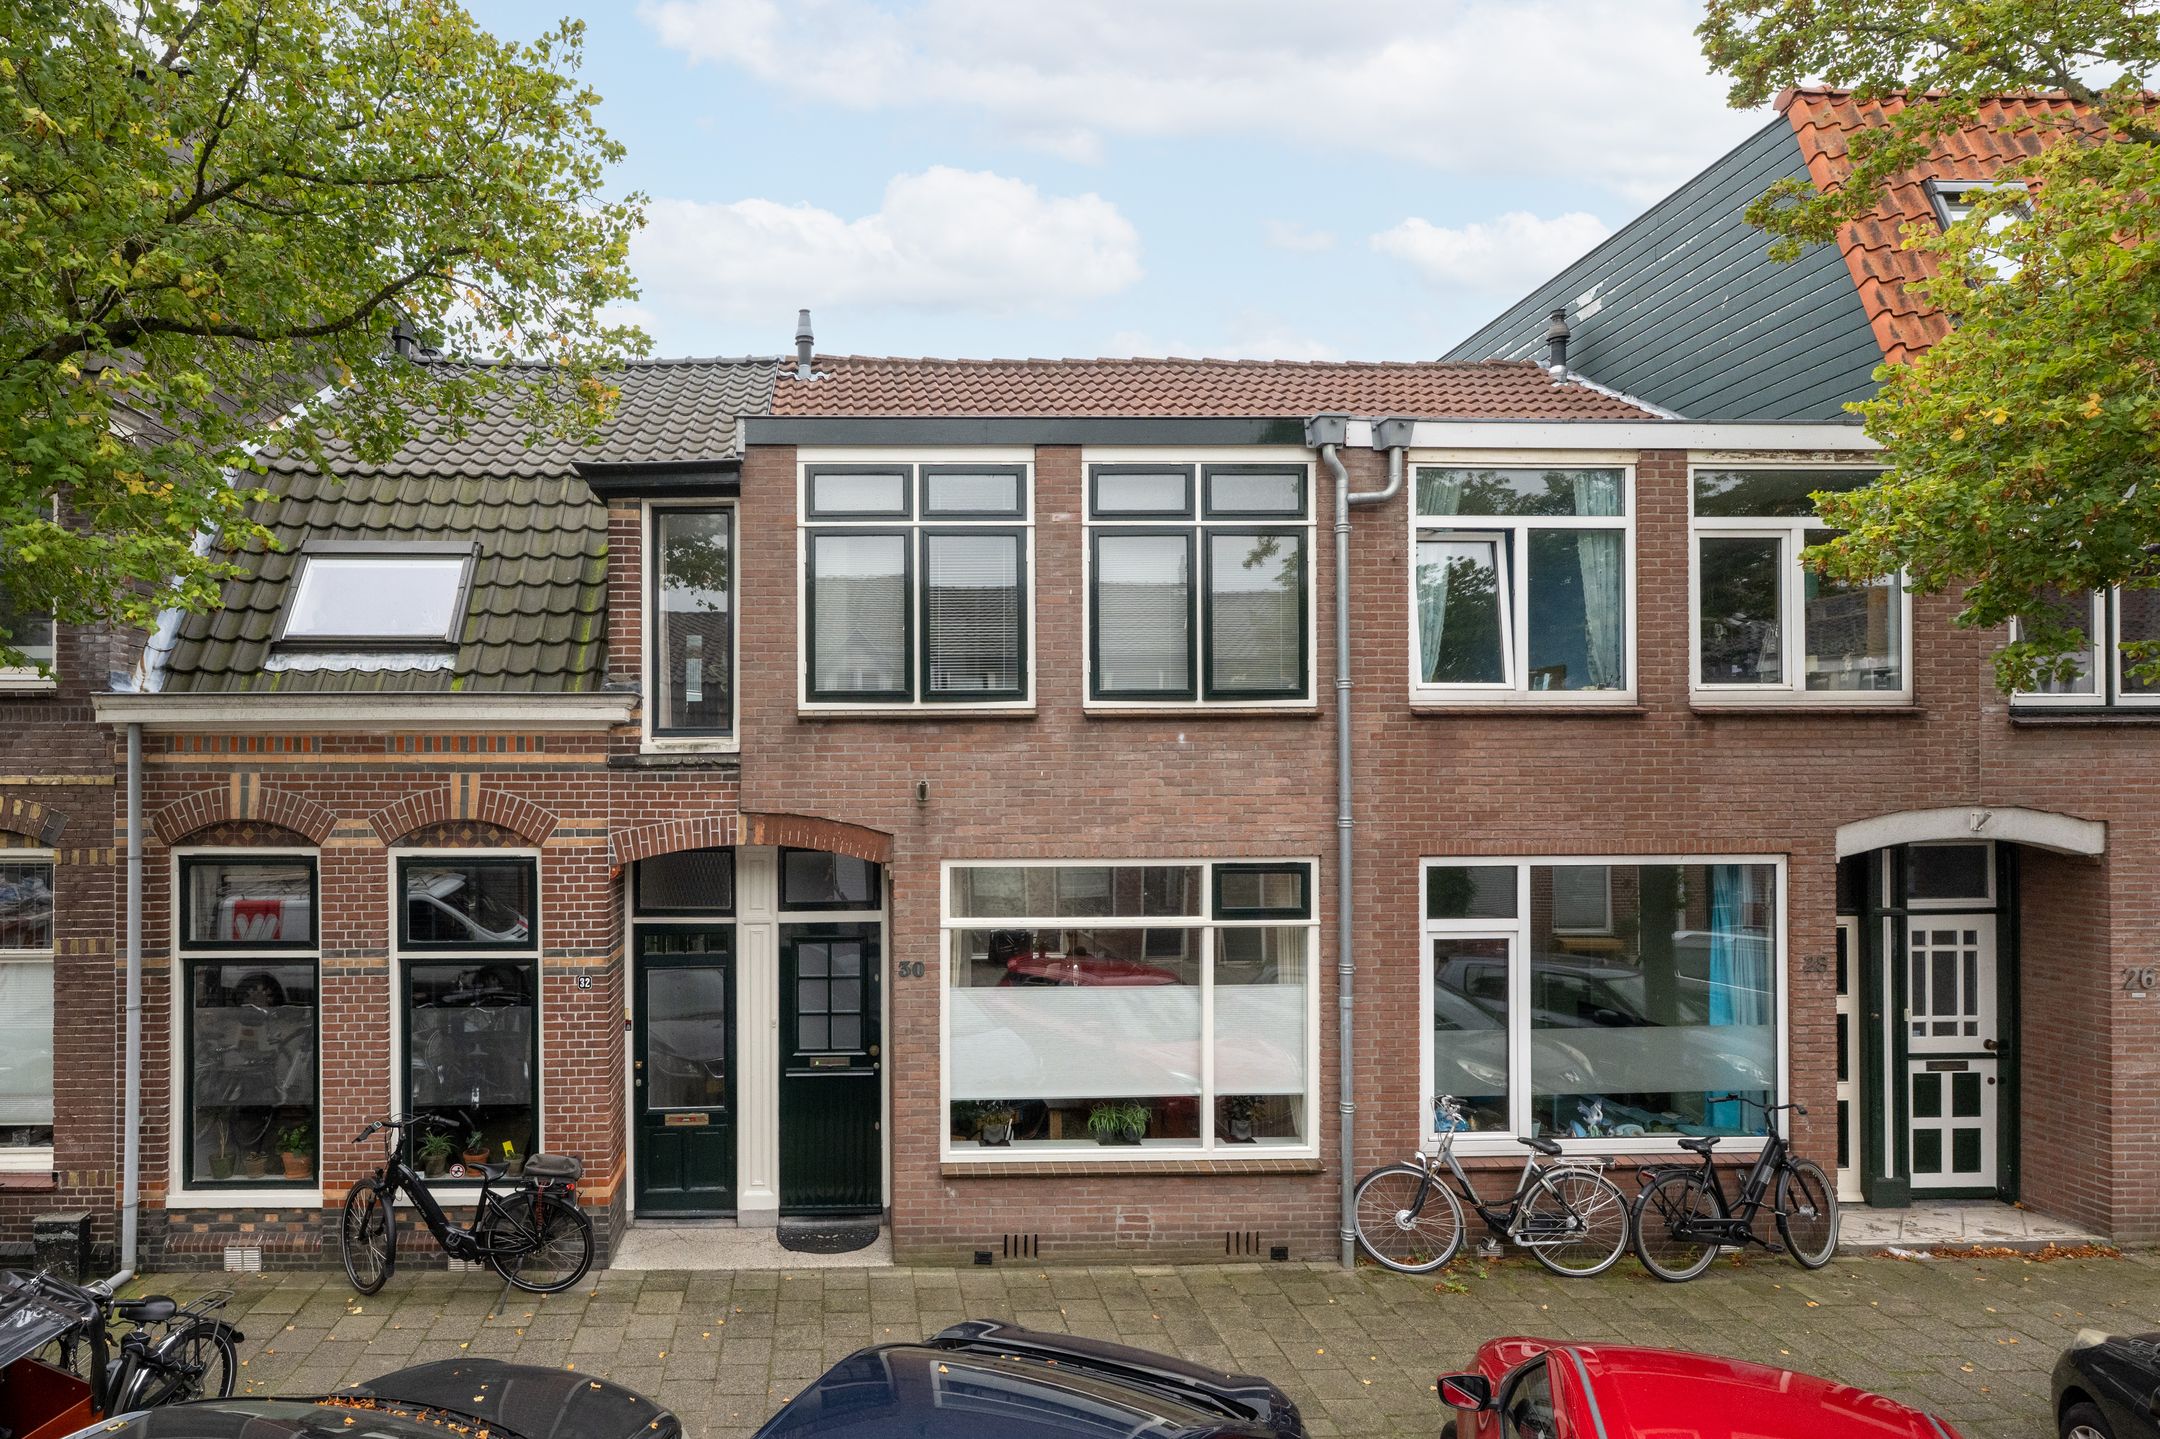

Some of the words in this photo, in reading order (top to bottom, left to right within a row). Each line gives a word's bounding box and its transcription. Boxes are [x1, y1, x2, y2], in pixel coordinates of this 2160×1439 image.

[898, 960, 925, 977] 30
[579, 977, 590, 988] 32
[2123, 966, 2156, 990] 26
